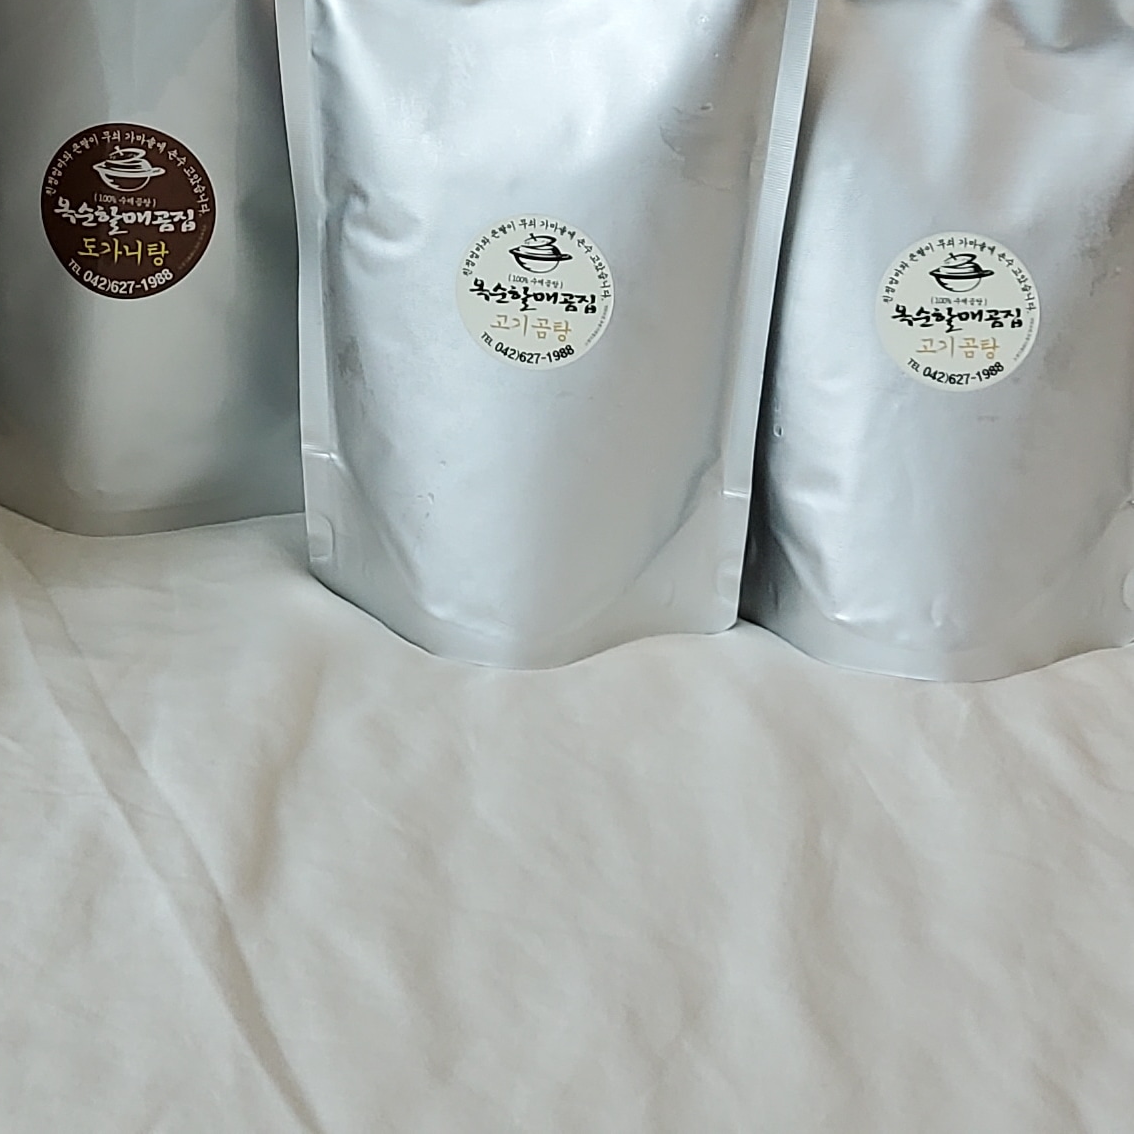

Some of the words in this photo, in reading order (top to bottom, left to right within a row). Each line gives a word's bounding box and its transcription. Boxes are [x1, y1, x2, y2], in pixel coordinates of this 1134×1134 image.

[101, 130, 121, 143] 무쇠
[518, 218, 536, 230] 무쇠
[936, 237, 955, 249] 무쇠
[77, 237, 170, 266] 도가니탕
[68, 258, 81, 276] TEL
[480, 331, 493, 347] TEL
[907, 357, 921, 373] TEL
